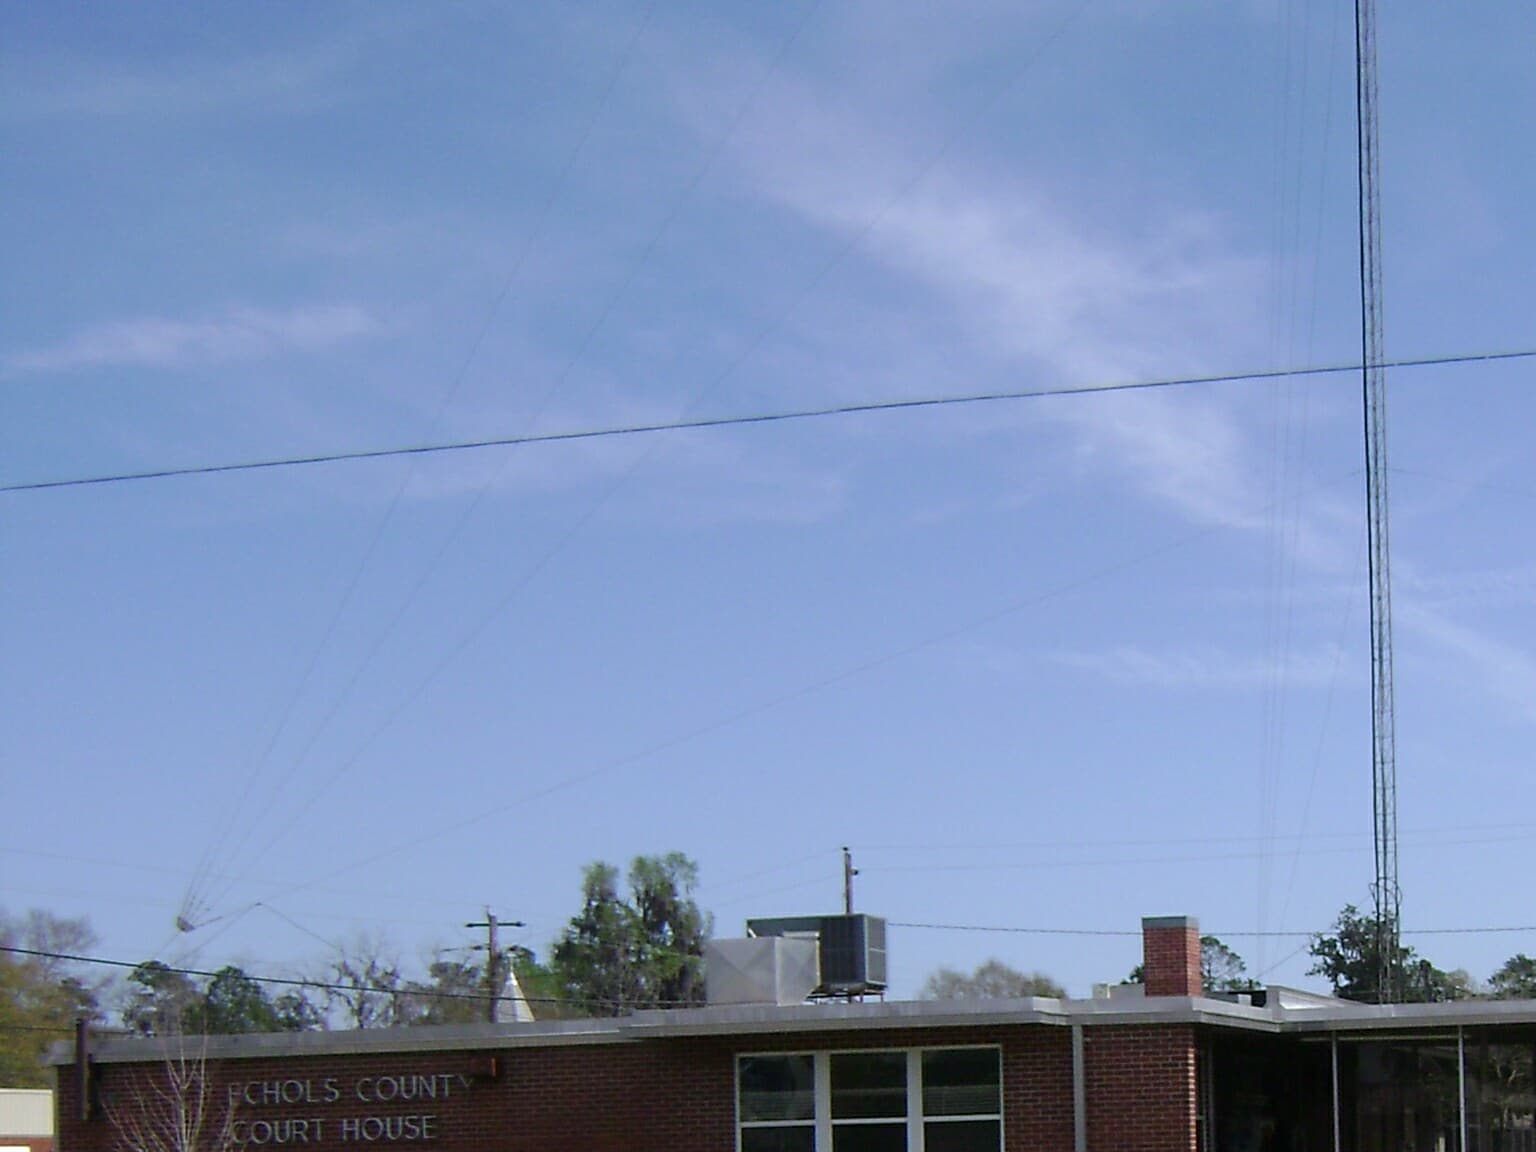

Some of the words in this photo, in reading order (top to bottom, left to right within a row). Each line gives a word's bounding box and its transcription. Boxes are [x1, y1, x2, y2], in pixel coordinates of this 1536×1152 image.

[228, 1078, 341, 1106] ECHOLS
[356, 1074, 474, 1101] COUNTY
[231, 1119, 325, 1144] COURT
[343, 1115, 438, 1141] HOUSE
